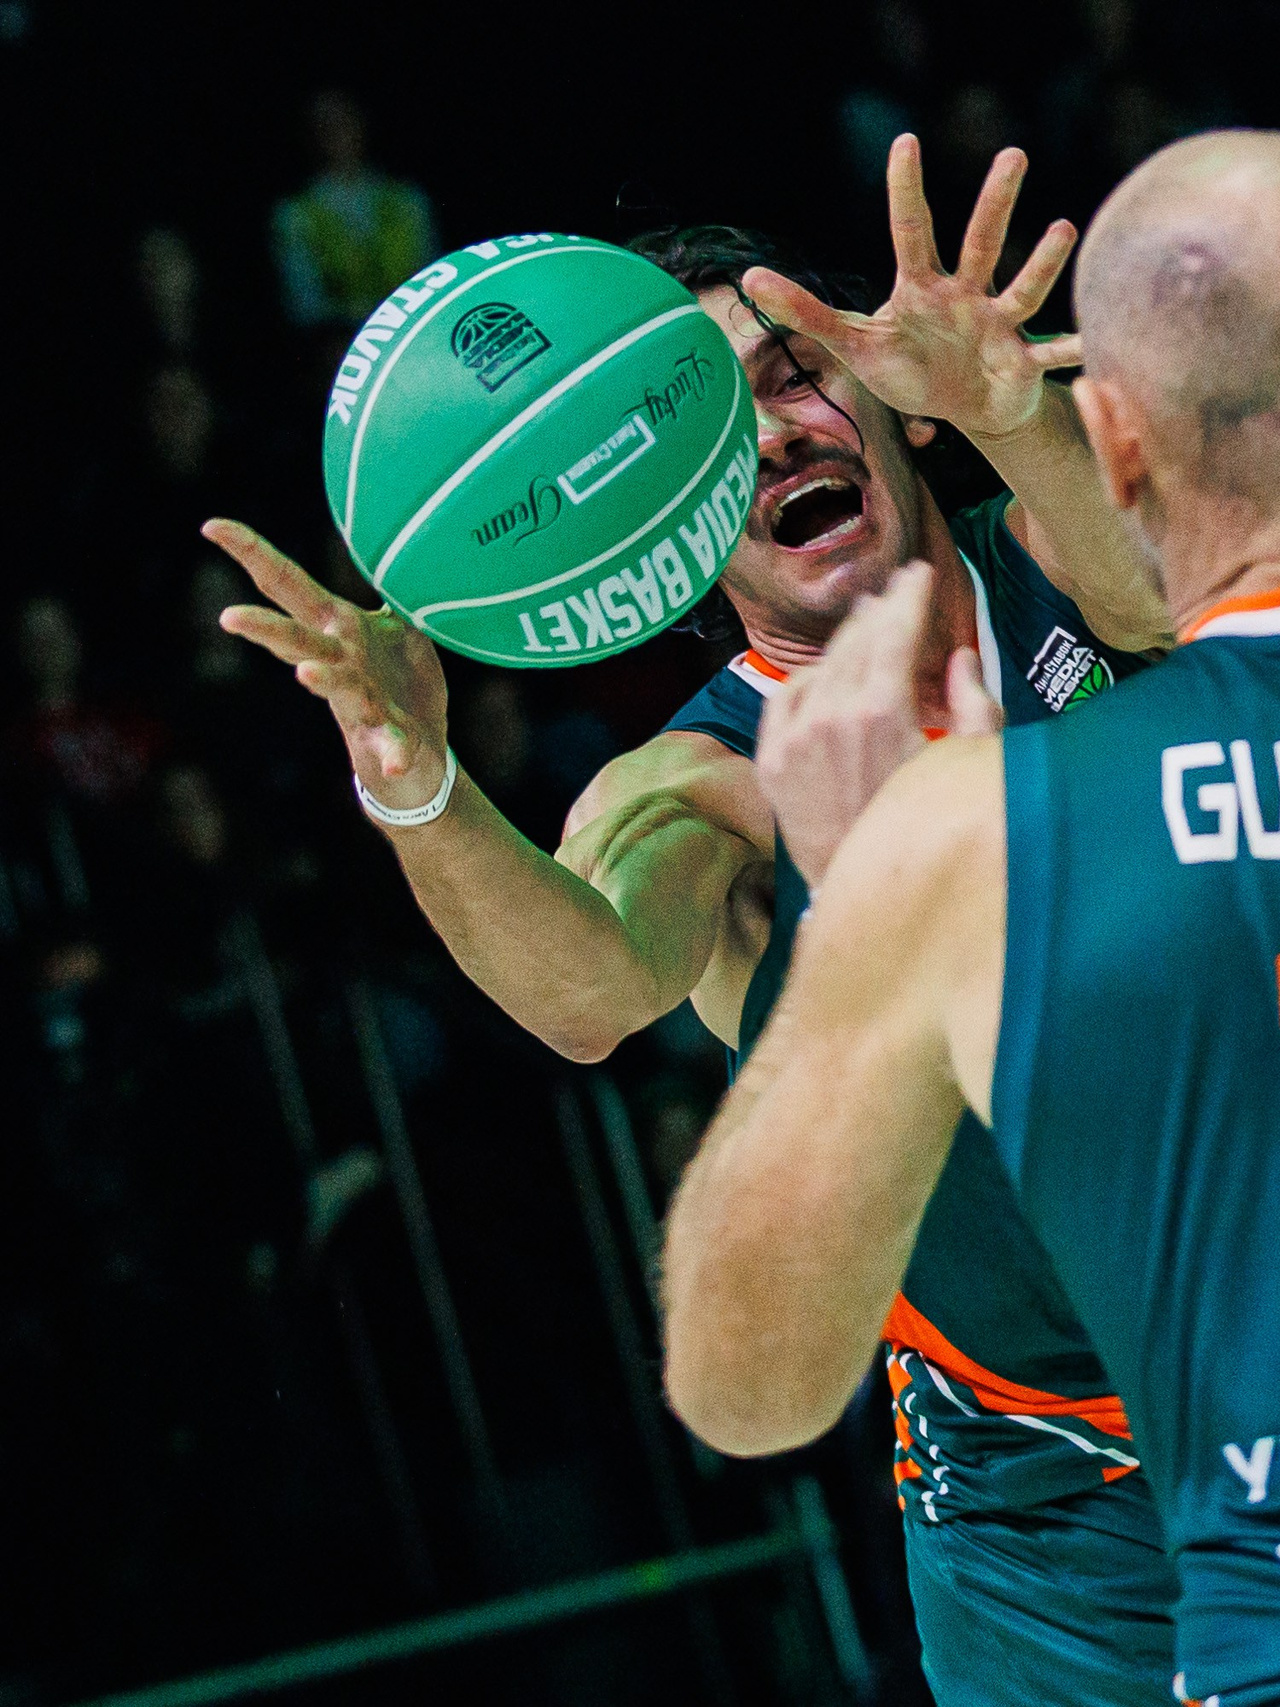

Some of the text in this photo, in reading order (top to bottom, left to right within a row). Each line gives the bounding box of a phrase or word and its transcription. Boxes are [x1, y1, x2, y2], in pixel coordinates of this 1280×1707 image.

[328, 262, 458, 425] STAVOK
[619, 347, 715, 426] Lucky
[471, 474, 562, 547] Team
[678, 433, 756, 580] MEDIA
[518, 536, 694, 652] BASKET
[1044, 647, 1090, 704] MEDIA
